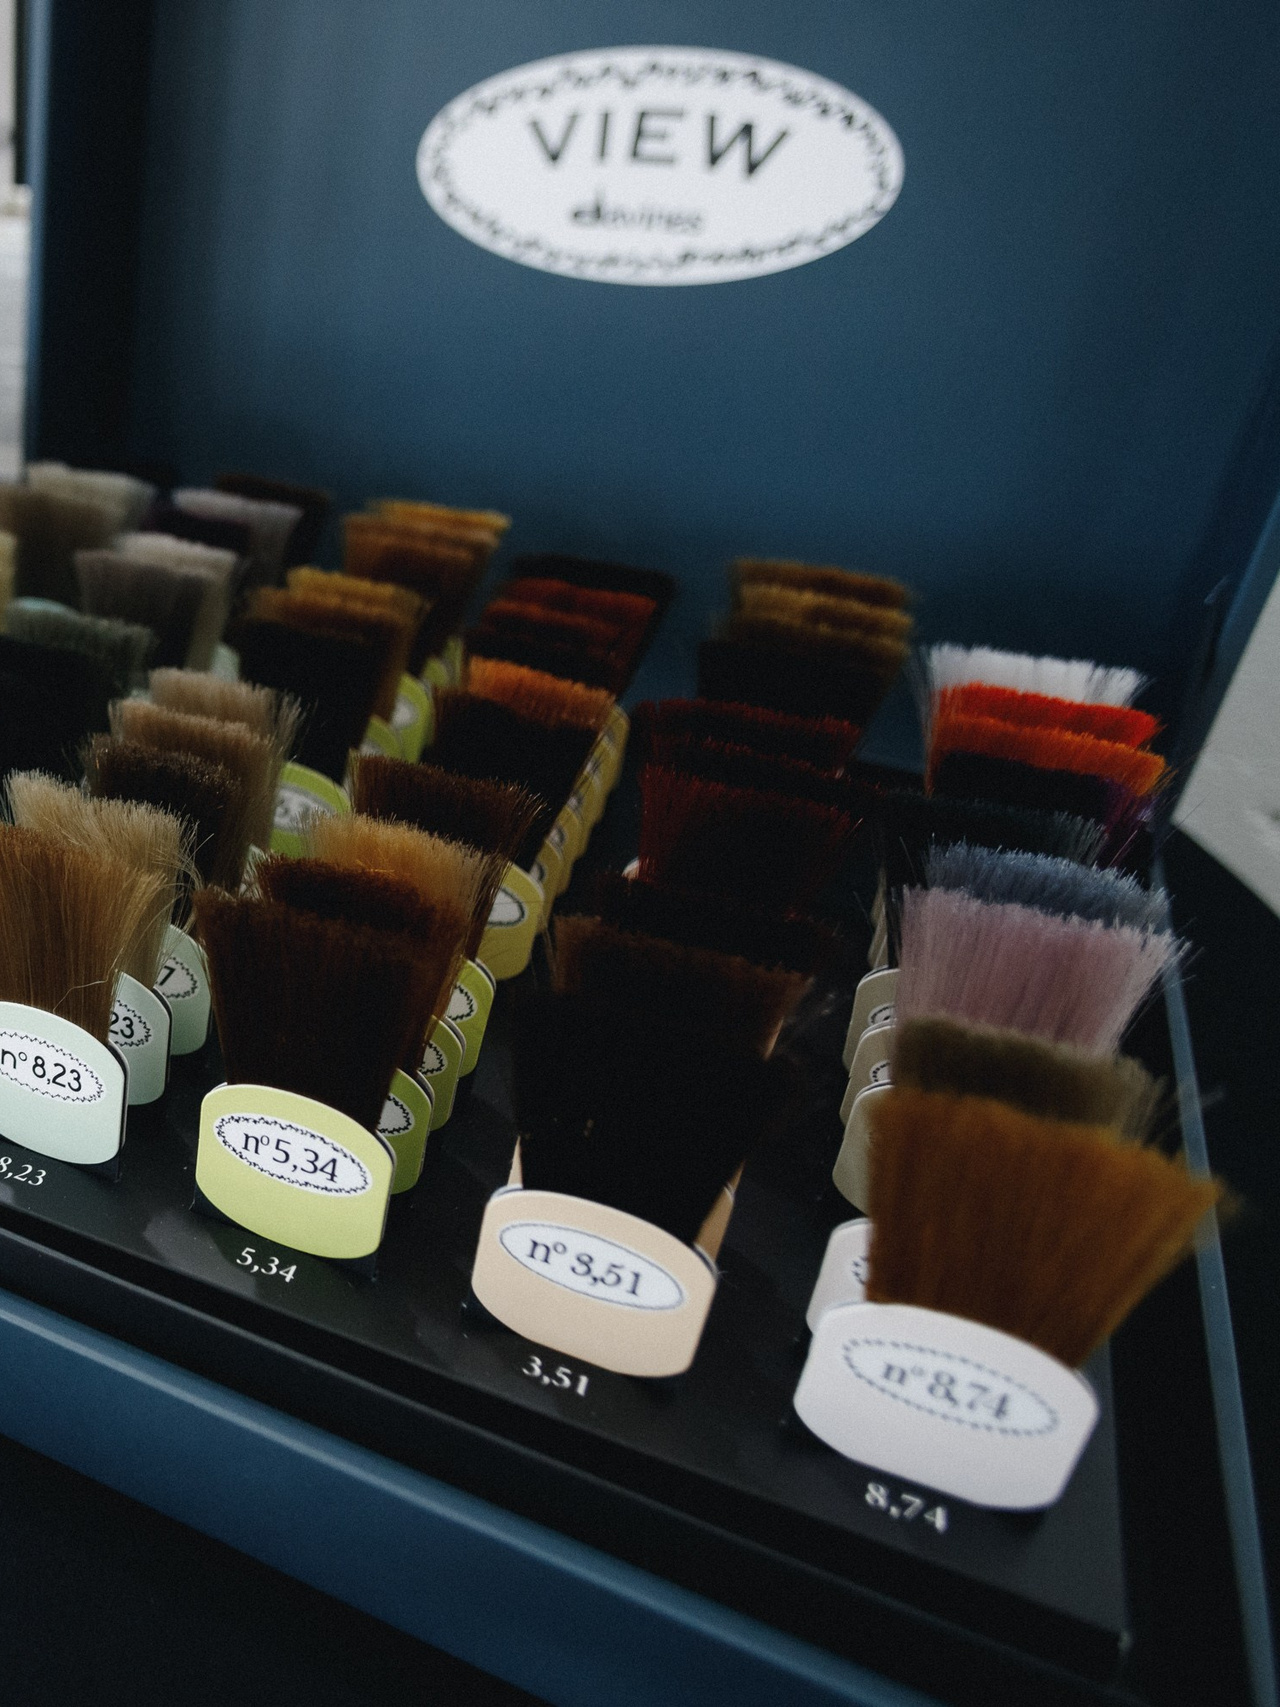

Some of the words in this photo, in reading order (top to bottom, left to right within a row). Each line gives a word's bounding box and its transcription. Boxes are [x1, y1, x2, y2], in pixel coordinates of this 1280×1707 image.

[528, 106, 789, 176] VIEW
[235, 1246, 298, 1284] 5,34
[521, 1355, 590, 1397] 3,51
[863, 1481, 949, 1534] 8,74
